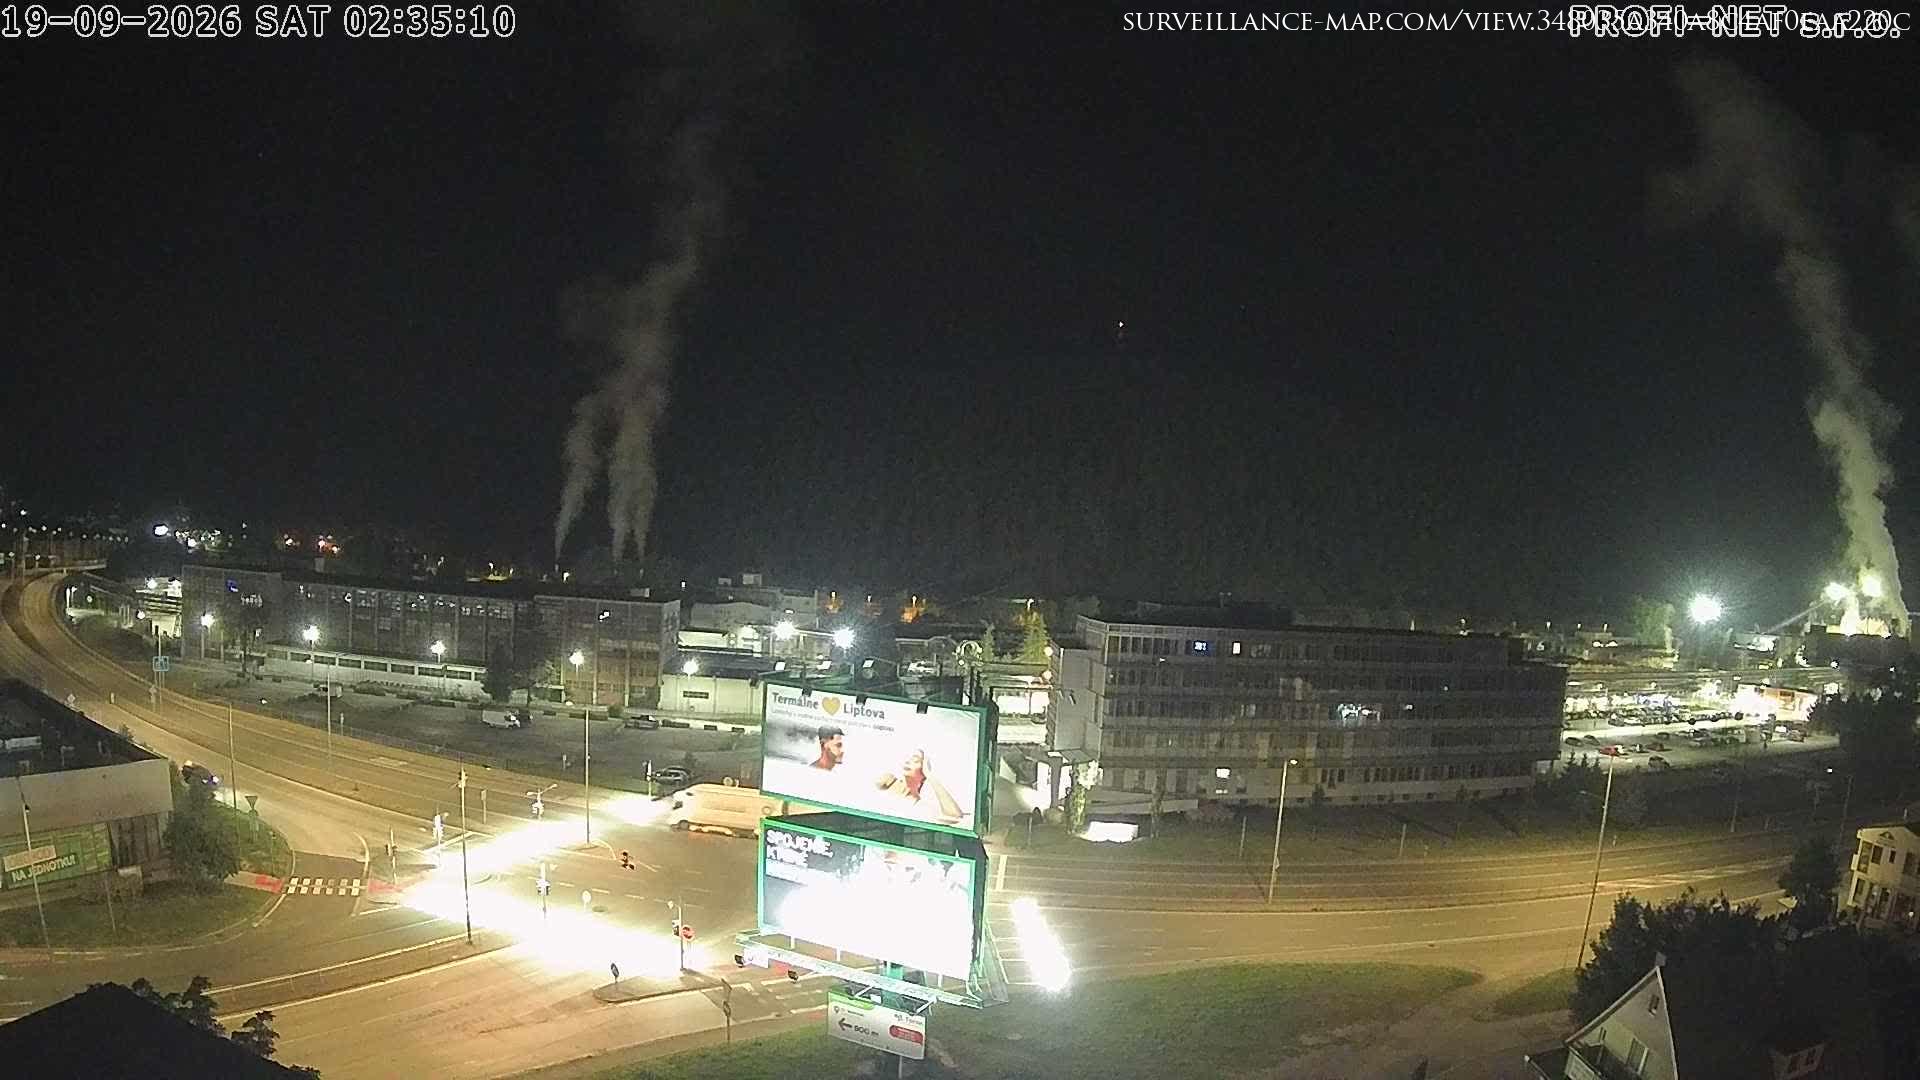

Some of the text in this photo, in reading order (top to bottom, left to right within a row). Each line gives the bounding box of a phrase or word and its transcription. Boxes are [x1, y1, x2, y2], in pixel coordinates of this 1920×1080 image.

[772, 692, 885, 719] Termálne Liptova
[11, 870, 27, 883] NA
